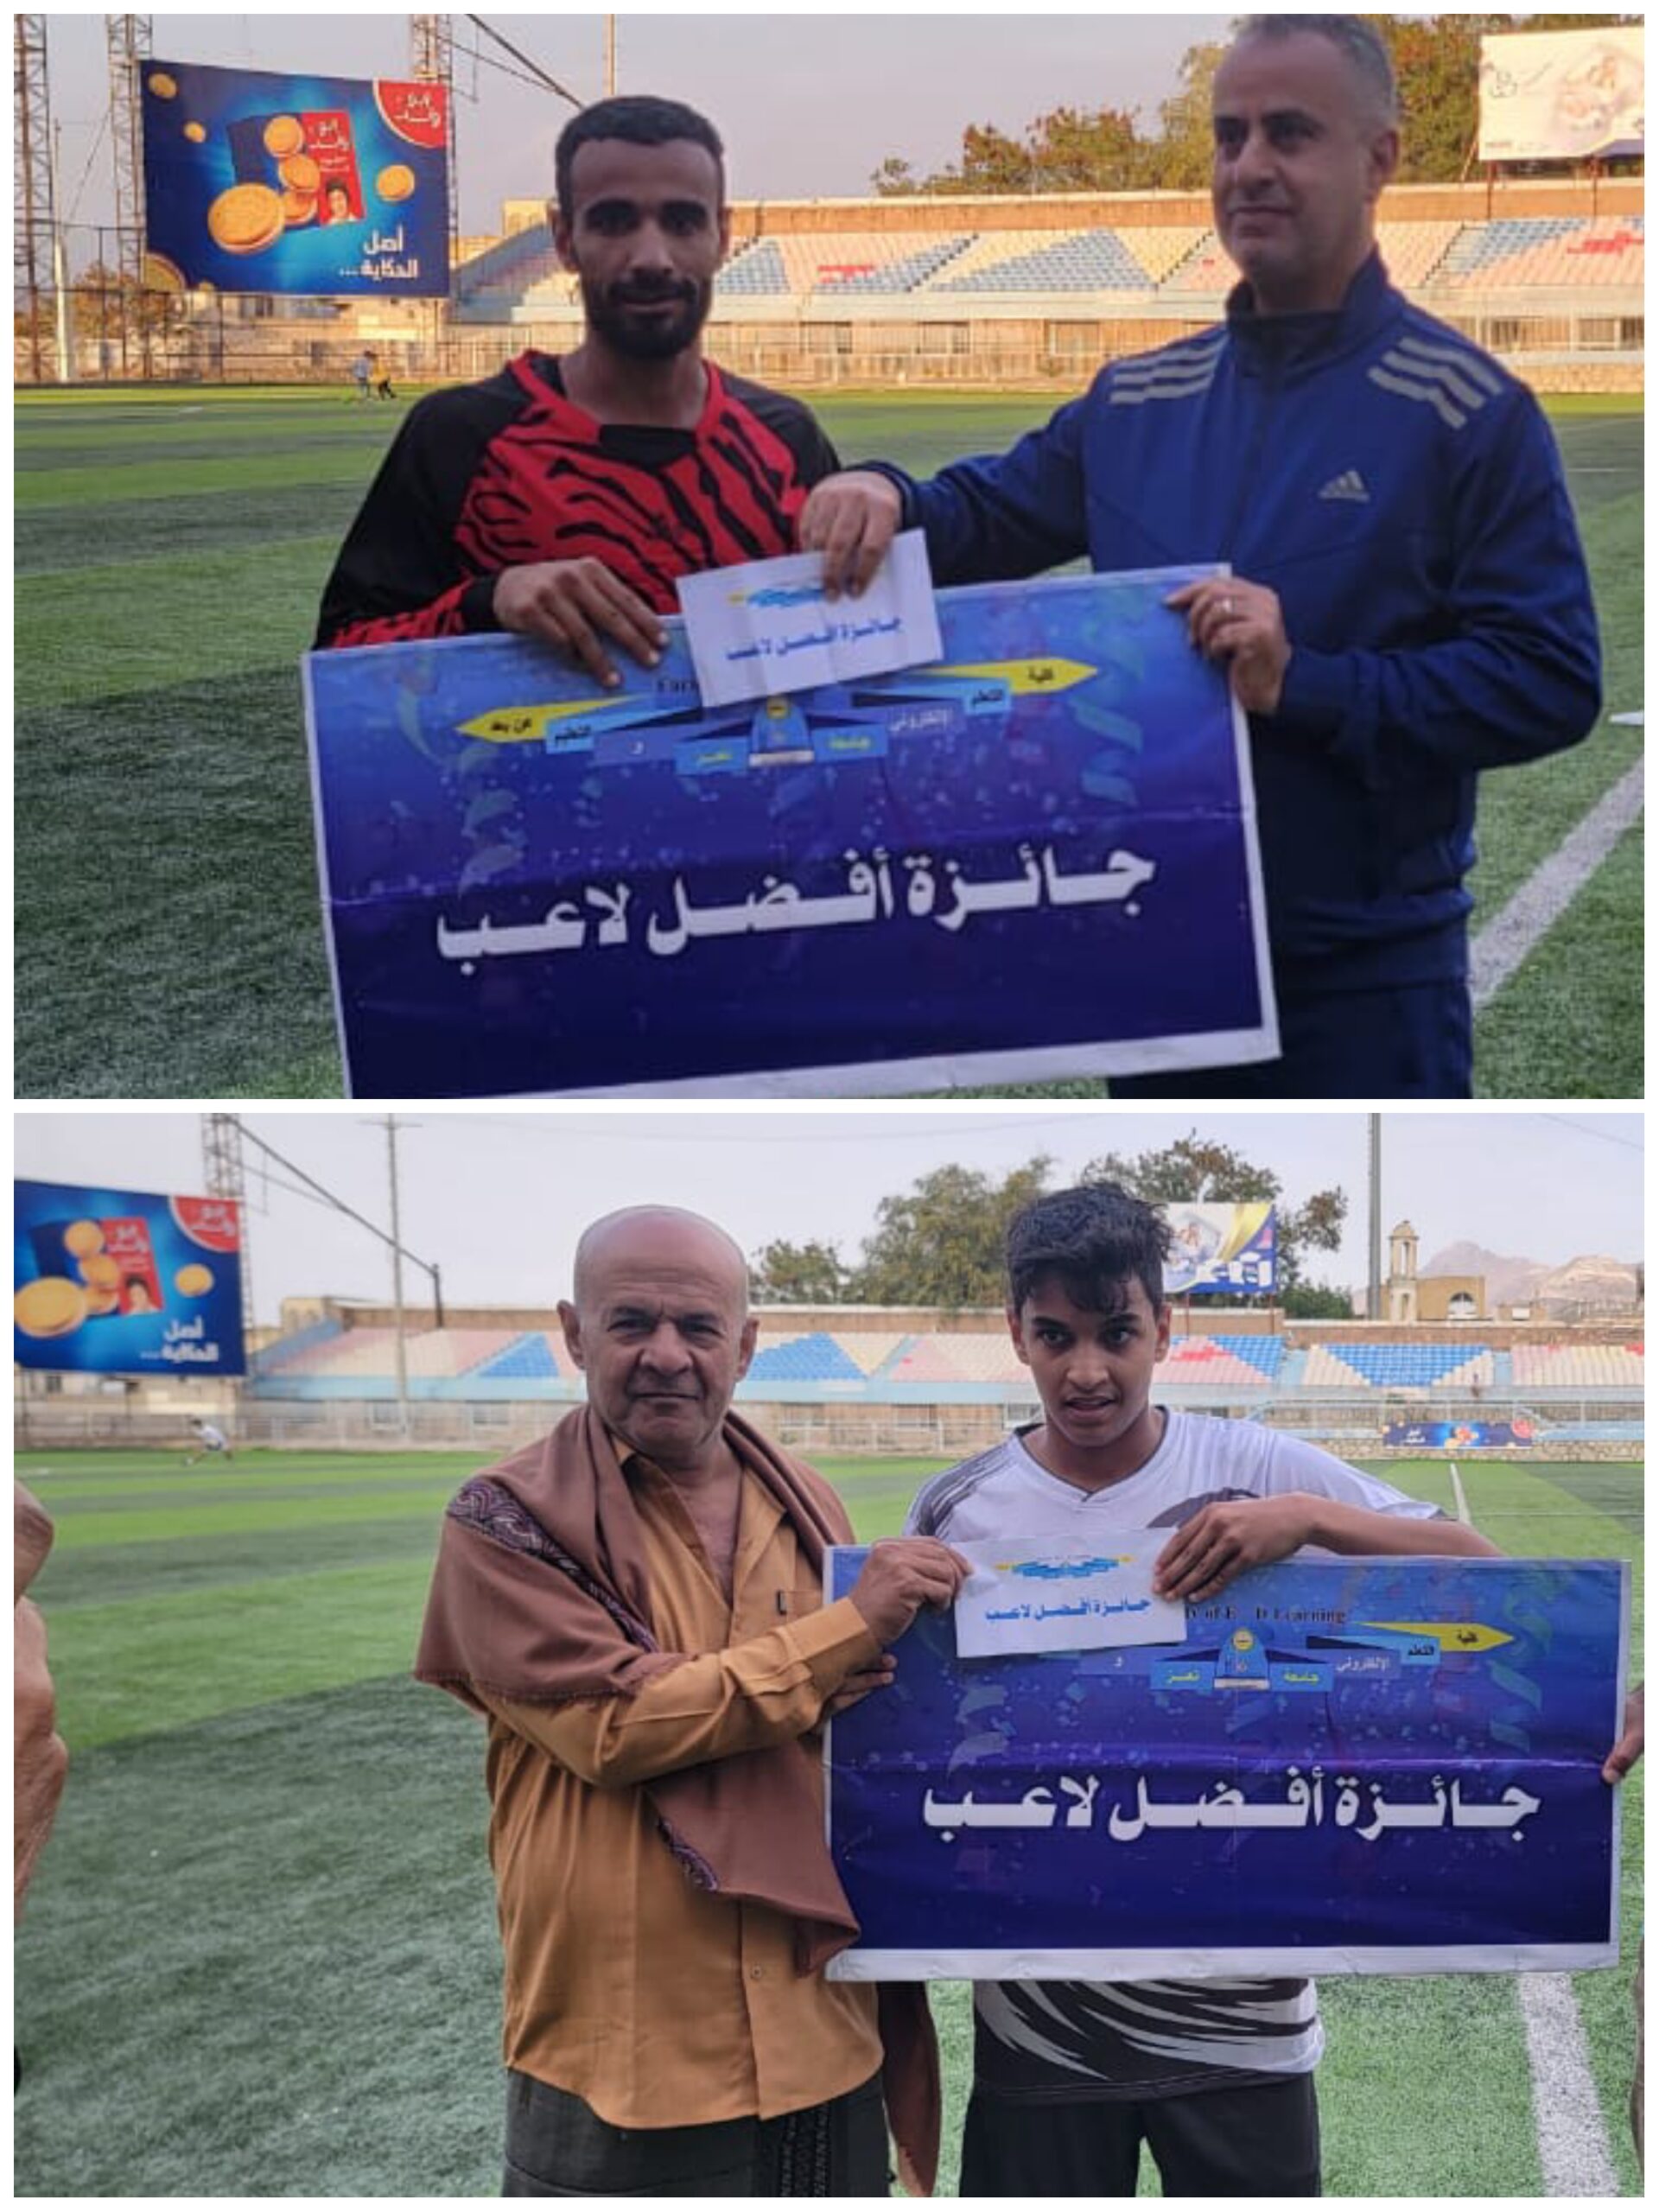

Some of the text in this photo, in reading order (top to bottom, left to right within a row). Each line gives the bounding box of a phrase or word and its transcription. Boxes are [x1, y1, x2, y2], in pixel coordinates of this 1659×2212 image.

[436, 845, 1154, 975] جائزة أفضل لاعب
[923, 1764, 1541, 1842] جائزة أفضل لاعب
